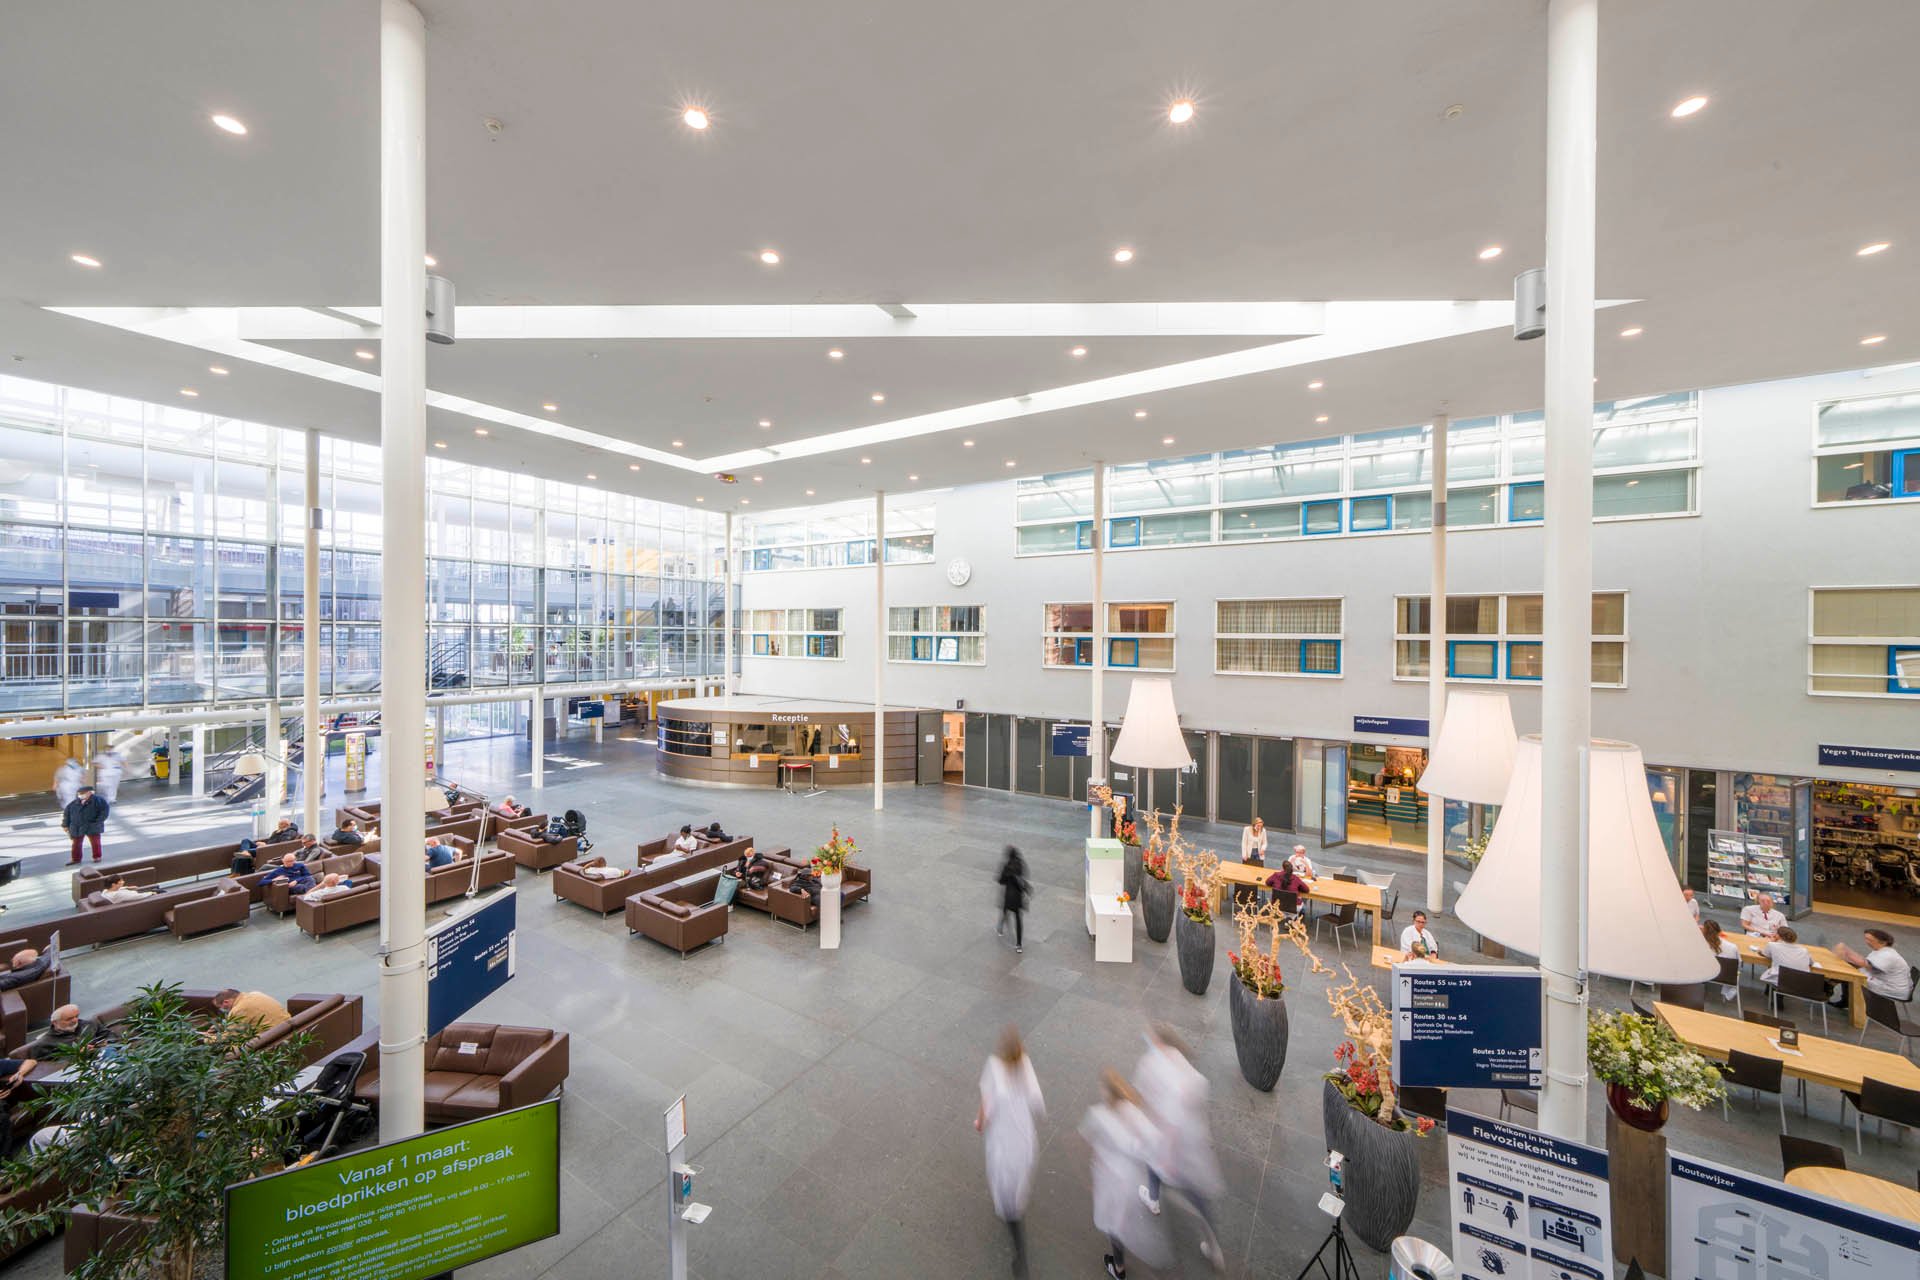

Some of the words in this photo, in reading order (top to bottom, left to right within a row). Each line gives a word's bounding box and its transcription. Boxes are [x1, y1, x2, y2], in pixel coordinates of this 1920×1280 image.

[772, 714, 808, 723] Receptie
[1823, 748, 1847, 756] Vegro
[1850, 750, 1920, 760] Thuiszorgwinke
[439, 931, 454, 942] Routes
[474, 949, 488, 961] Routes
[1472, 1126, 1578, 1166] Flevoziekenhuis
[1493, 1124, 1527, 1139] Welkom
[1529, 1133, 1537, 1141] in
[1539, 1135, 1554, 1147] het
[339, 1158, 395, 1185] Vanaf
[400, 1156, 407, 1169] 1
[415, 1139, 471, 1166] maart:
[1457, 1149, 1468, 1159] wij
[1476, 1155, 1513, 1172] vriendelijk
[1515, 1167, 1529, 1177] zich
[1532, 1173, 1545, 1182] aan
[1547, 1177, 1597, 1198] onderstaande
[1460, 1142, 1474, 1152] Voor
[1477, 1148, 1487, 1156] uw
[1500, 1155, 1516, 1165] onze
[1519, 1161, 1553, 1176] veiligheid
[1556, 1171, 1593, 1188] verzoeken
[1678, 1164, 1736, 1187] Routewijzer
[285, 1176, 409, 1222] bloedprikken
[414, 1170, 437, 1184] op
[442, 1145, 514, 1176] afspraak
[1488, 1168, 1524, 1185] richtlijnen
[1527, 1179, 1534, 1187] te
[1536, 1181, 1563, 1196] houden
[271, 1232, 298, 1246] Online
[301, 1228, 312, 1237] via
[271, 1242, 289, 1255] Lukt
[292, 1237, 304, 1248] dat
[326, 1226, 338, 1237] bel
[340, 1221, 355, 1233] met
[264, 1265, 271, 1273] U
[273, 1258, 290, 1270] blijft
[293, 1248, 324, 1264] welkom
[326, 1239, 353, 1255] zonder
